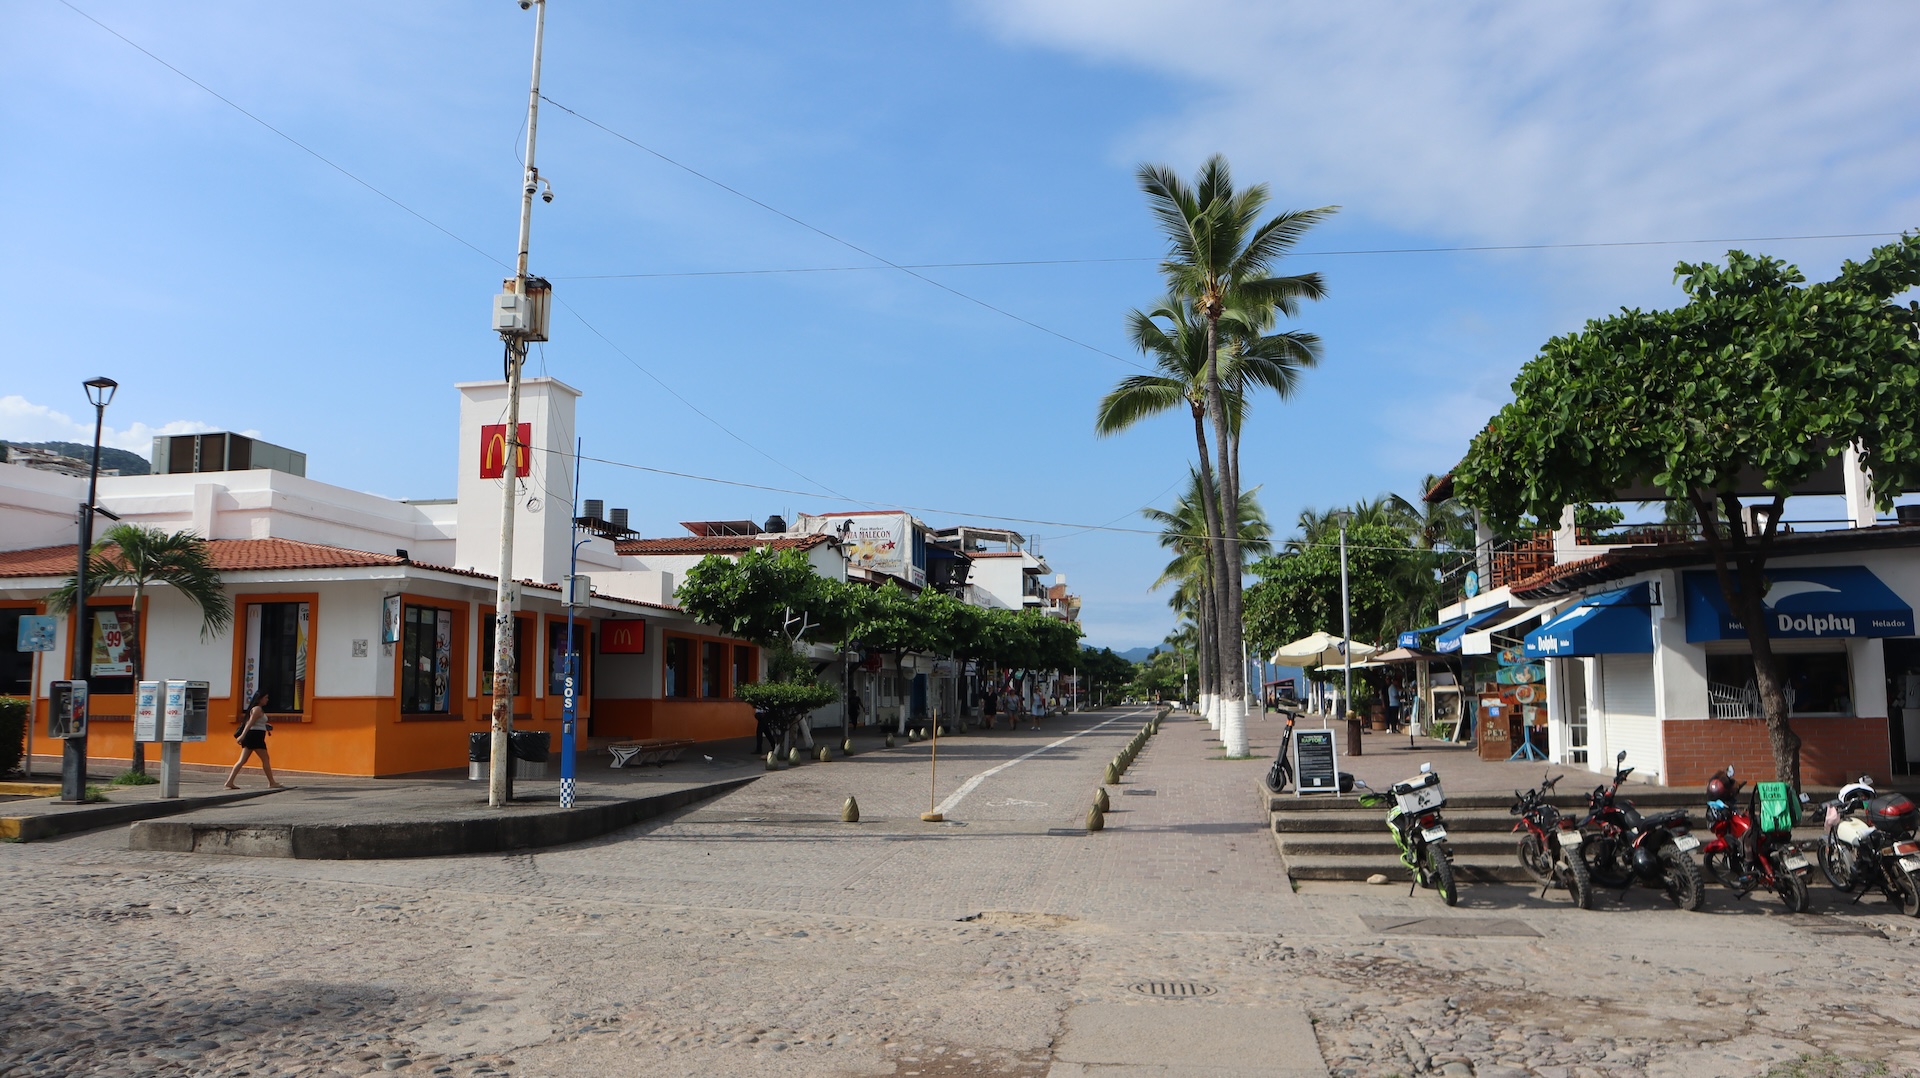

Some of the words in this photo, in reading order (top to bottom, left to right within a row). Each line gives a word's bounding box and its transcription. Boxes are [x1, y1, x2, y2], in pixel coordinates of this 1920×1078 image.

[1778, 614, 1856, 636] Dolphy
[1538, 634, 1558, 654] Dolphy
[564, 677, 574, 708] SOS
